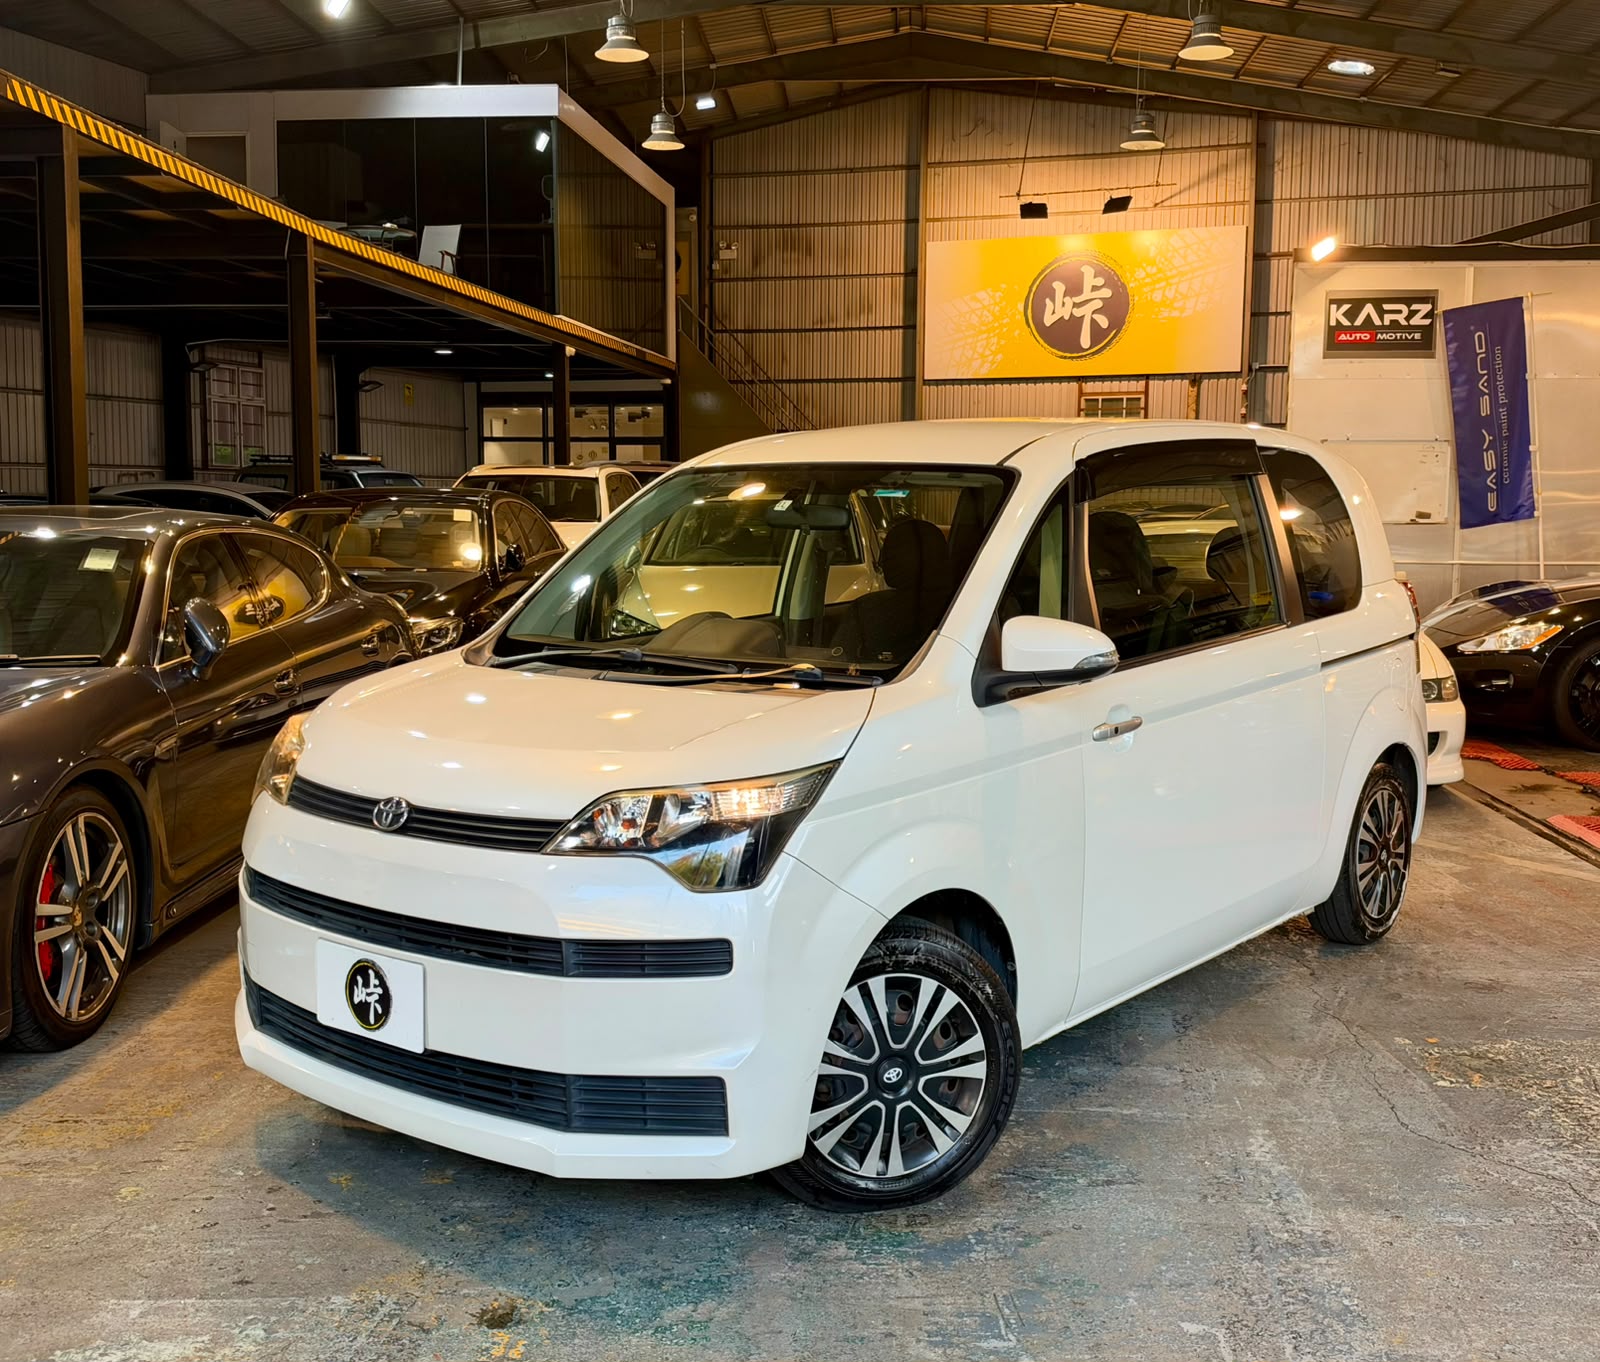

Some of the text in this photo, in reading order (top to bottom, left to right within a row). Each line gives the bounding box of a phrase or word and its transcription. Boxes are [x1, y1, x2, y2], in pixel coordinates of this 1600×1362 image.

[1043, 264, 1113, 349] 峠
[1329, 303, 1433, 326] KARZ
[1338, 332, 1422, 341] AUTO MOTIVE
[1474, 331, 1497, 512] EASY SAND
[1493, 345, 1510, 484] ceramic paint protection
[353, 968, 383, 1025] 峠
